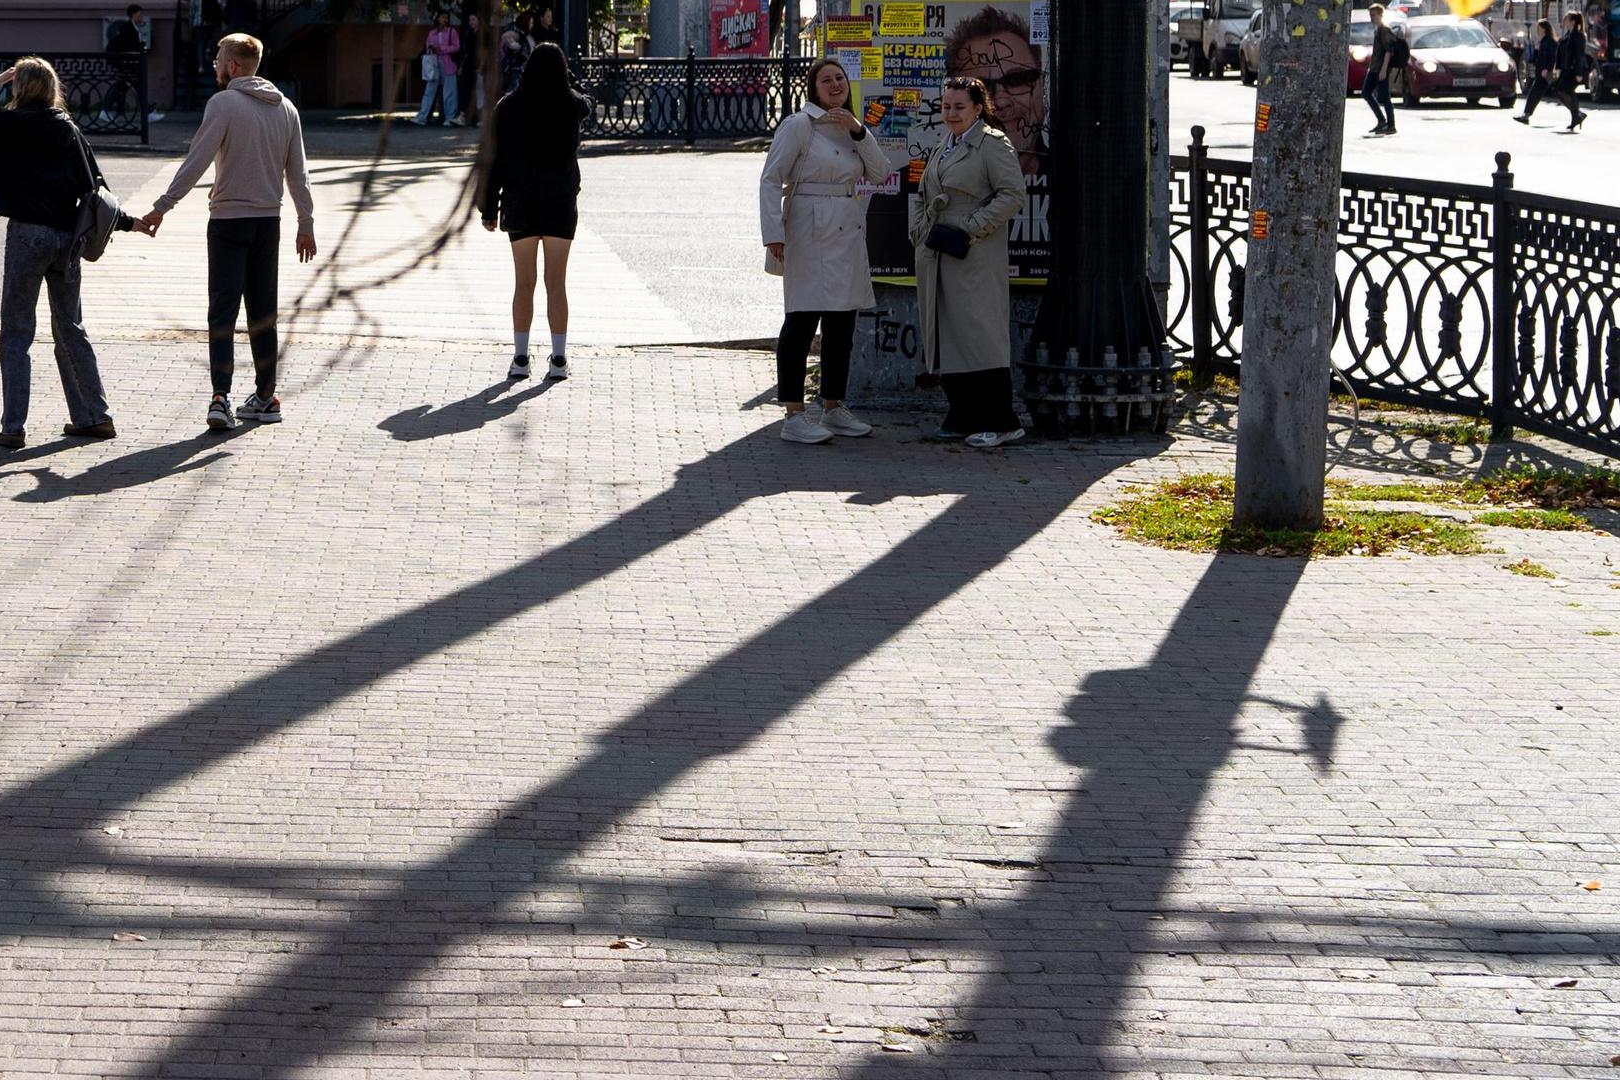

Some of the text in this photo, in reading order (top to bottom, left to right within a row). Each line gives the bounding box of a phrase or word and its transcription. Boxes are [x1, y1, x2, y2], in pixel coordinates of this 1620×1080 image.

[719, 11, 756, 40] ДИСКАЧ
[884, 44, 946, 58] КРЕДИТ
[884, 58, 946, 69] БЕЗ СПРАВОК
